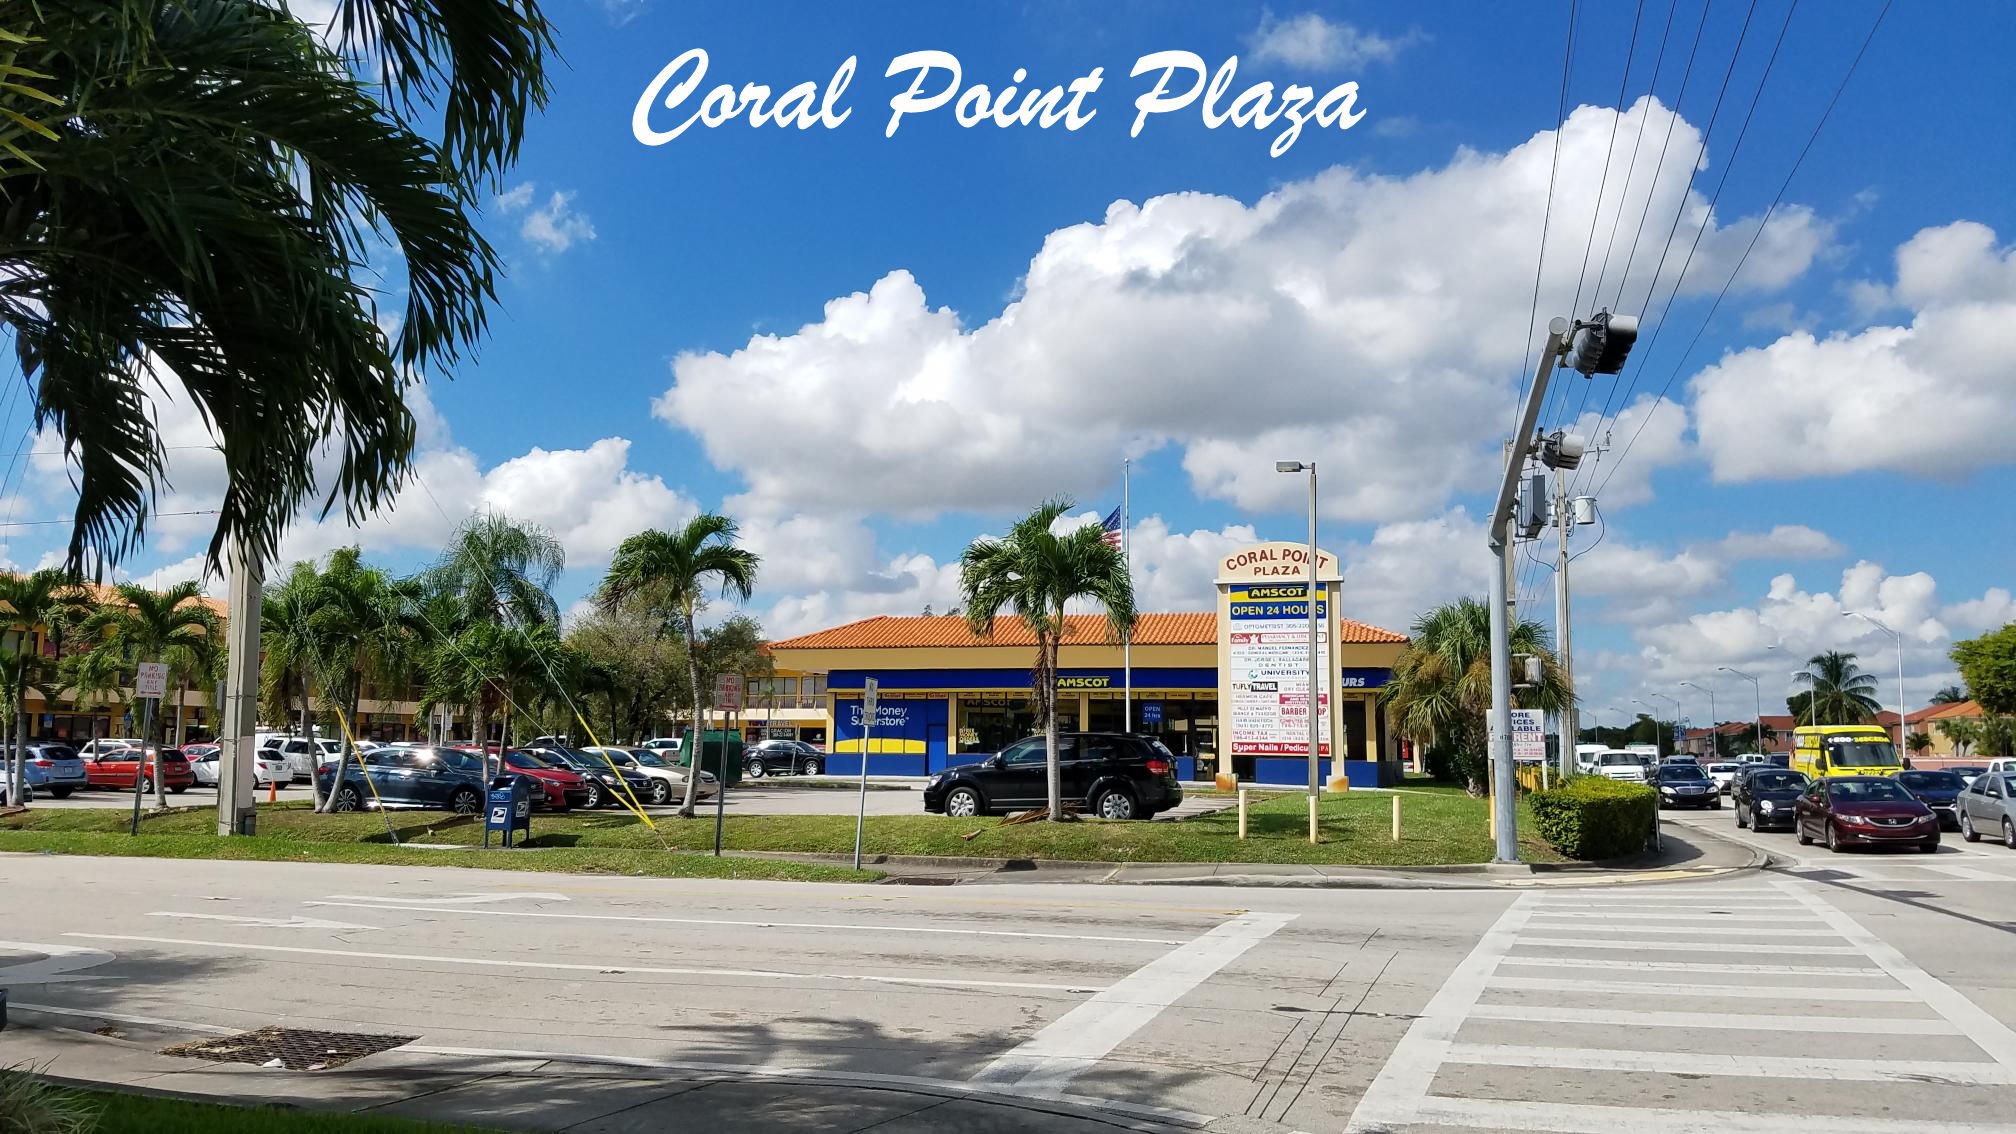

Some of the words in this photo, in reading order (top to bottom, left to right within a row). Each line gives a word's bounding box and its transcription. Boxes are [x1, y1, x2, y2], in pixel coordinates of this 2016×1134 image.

[1226, 548, 1278, 571] CORAL
[1254, 565, 1301, 576] PLAZA
[1251, 588, 1304, 597] AMSCOT
[1231, 606, 1264, 616] OPEN
[1266, 606, 1280, 615] 24
[1283, 605, 1325, 615] HOUS
[1057, 678, 1110, 687] AMSCOT
[1342, 677, 1365, 687] URS
[1281, 707, 1307, 715] BARBER
[1513, 732, 1544, 741] RENT
[1233, 743, 1257, 752] Super
[1258, 743, 1279, 751] Nails
